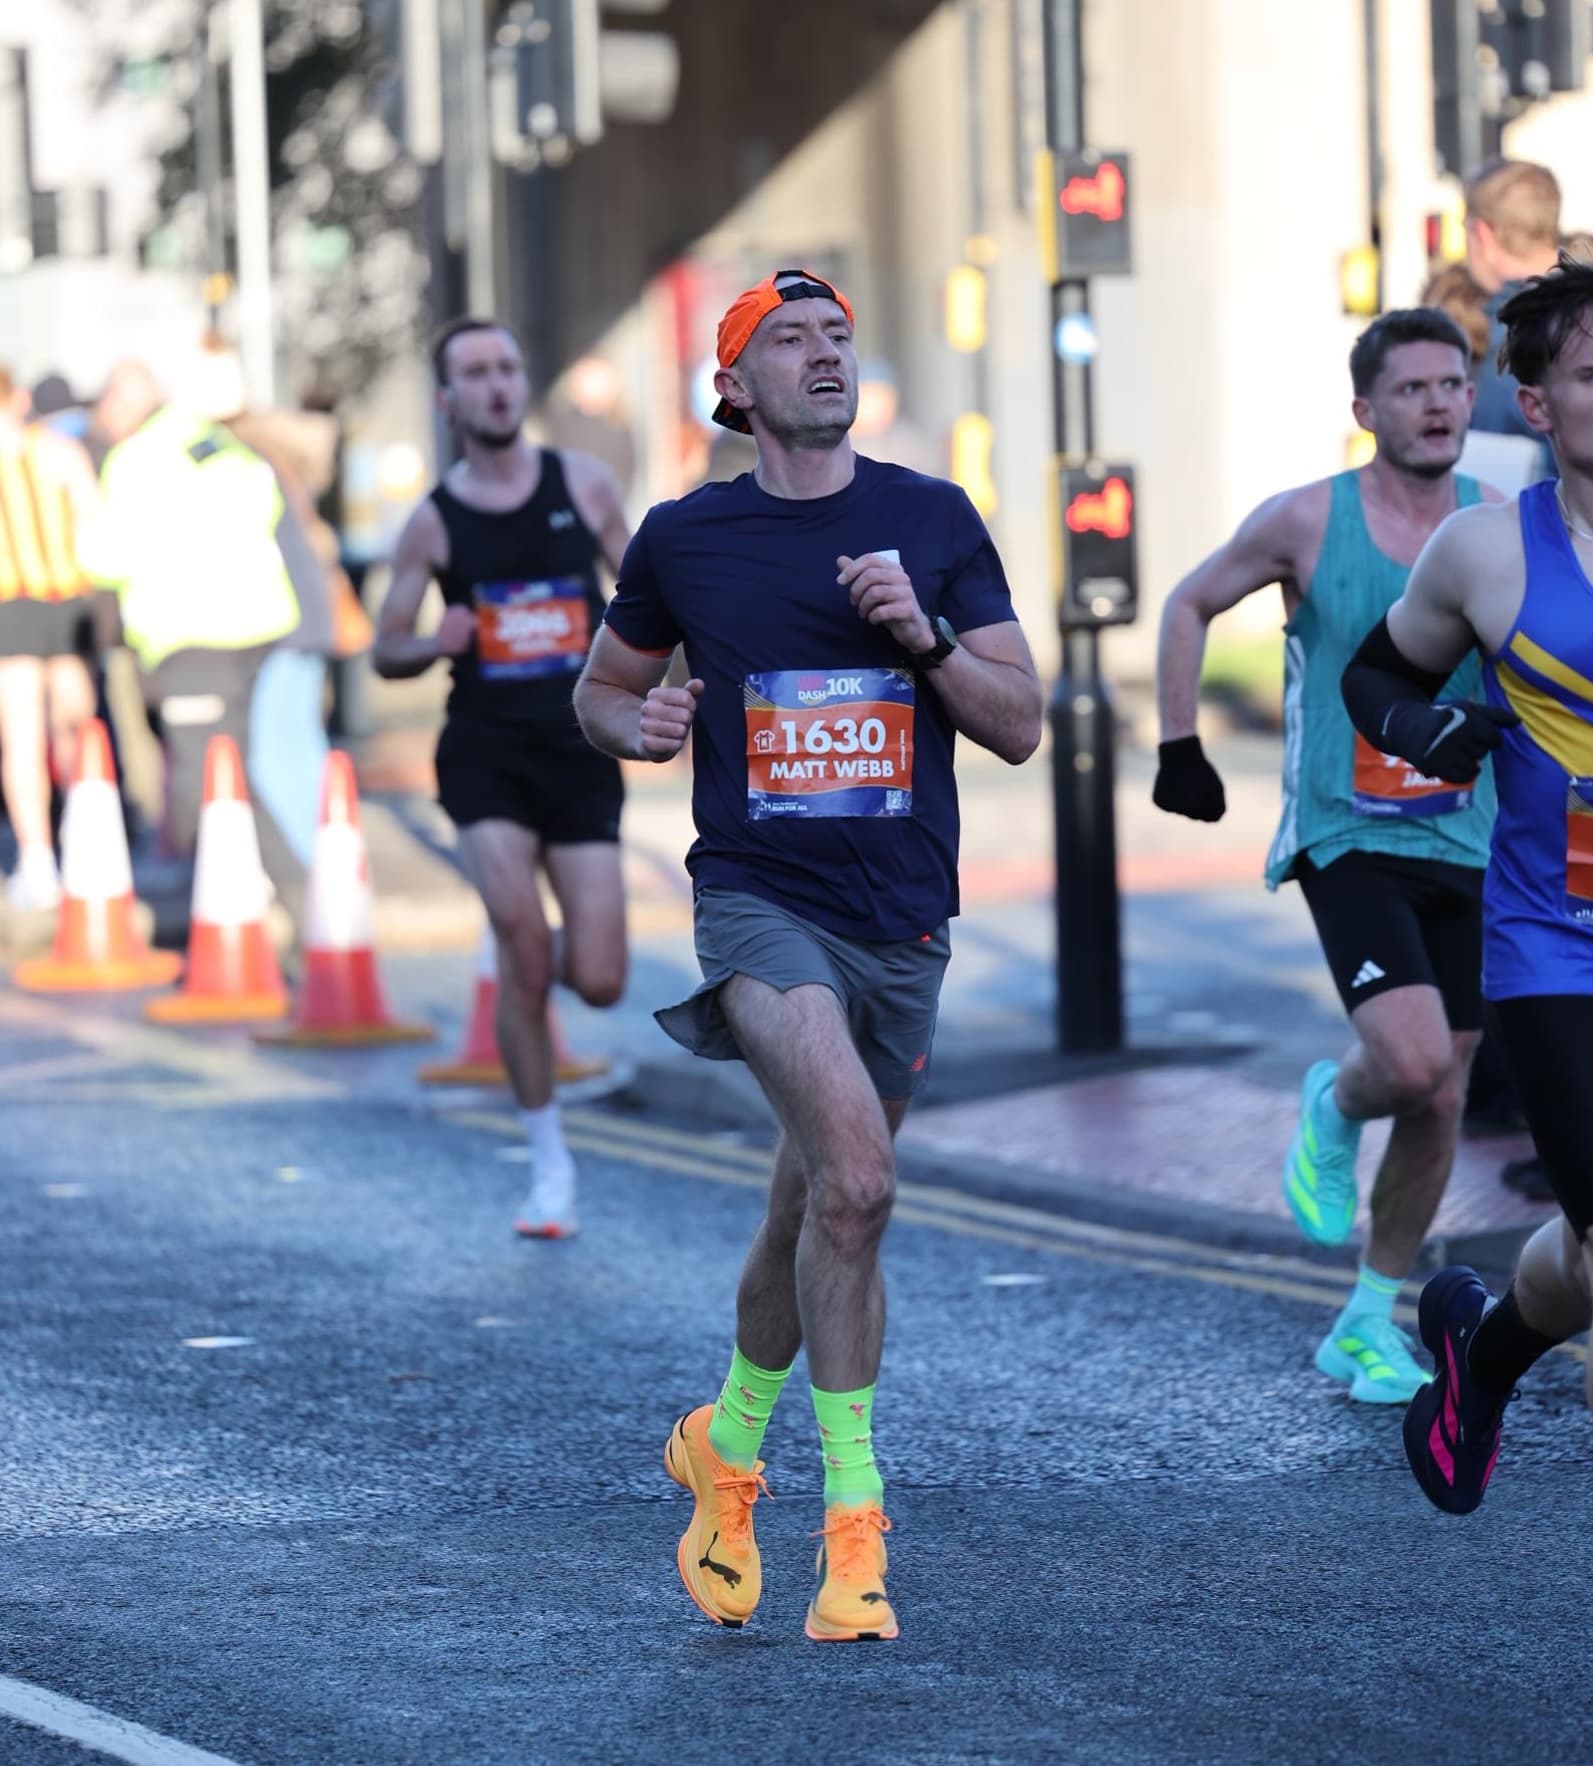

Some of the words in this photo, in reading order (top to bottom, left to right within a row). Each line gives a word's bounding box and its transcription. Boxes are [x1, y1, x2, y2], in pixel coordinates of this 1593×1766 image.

[798, 690, 826, 701] DASH
[826, 677, 863, 696] 10K
[780, 717, 887, 755] 1630
[770, 760, 827, 780] MATT
[833, 759, 895, 779] WEBB
